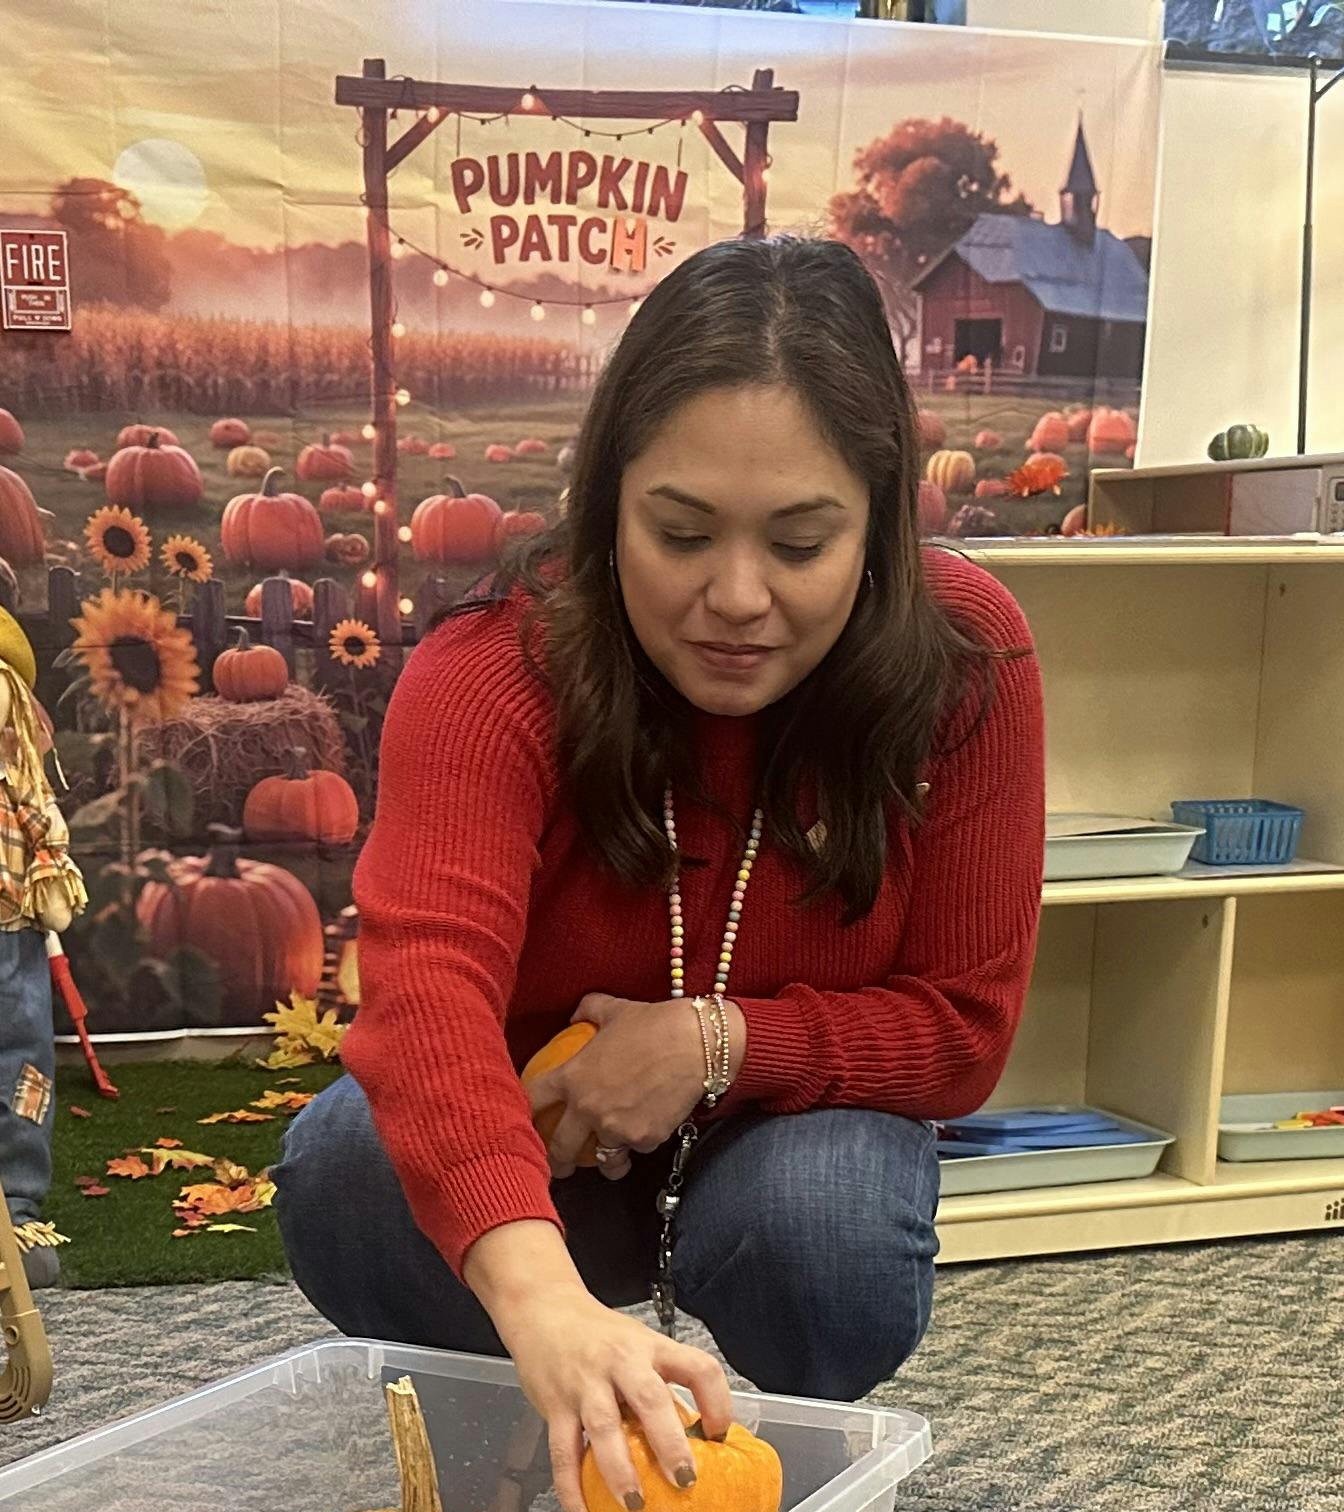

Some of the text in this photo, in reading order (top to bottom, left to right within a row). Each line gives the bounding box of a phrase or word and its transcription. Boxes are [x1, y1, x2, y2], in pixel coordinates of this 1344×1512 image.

[451, 151, 688, 222] PUMPKIN
[6, 244, 61, 280] FIRE
[490, 214, 647, 272] PATCH
